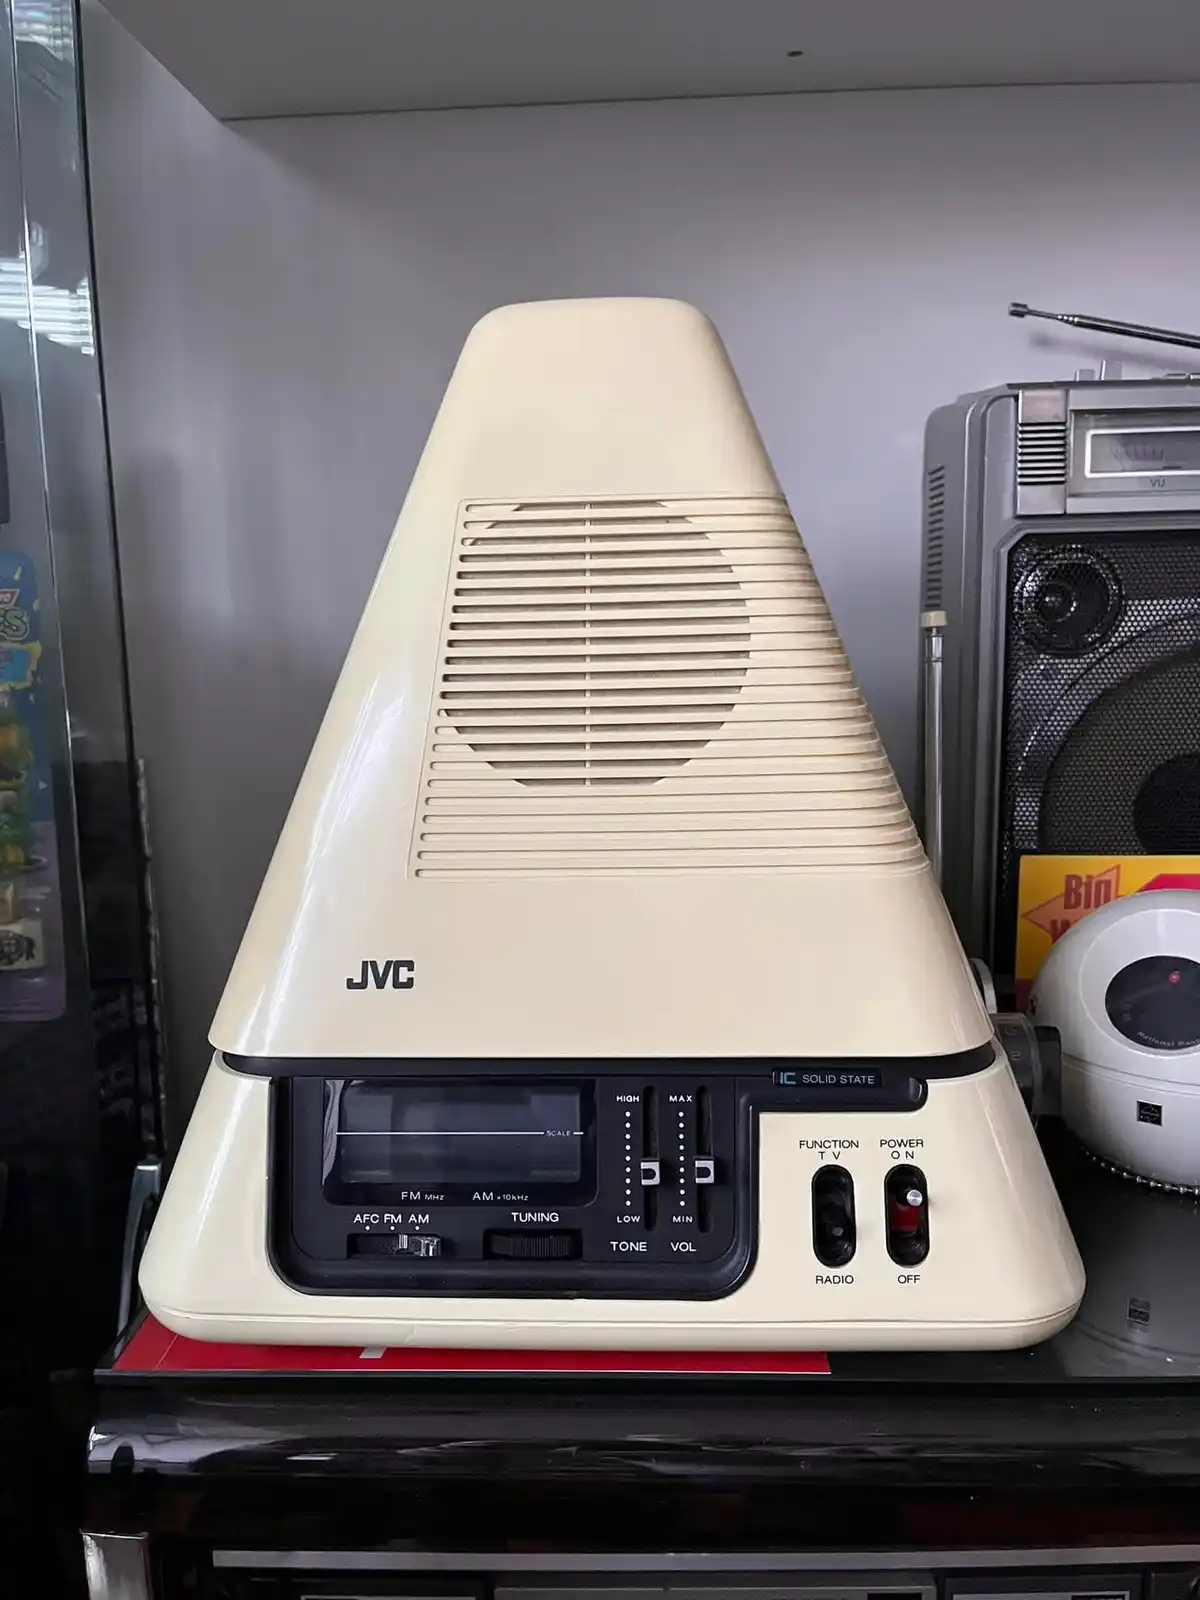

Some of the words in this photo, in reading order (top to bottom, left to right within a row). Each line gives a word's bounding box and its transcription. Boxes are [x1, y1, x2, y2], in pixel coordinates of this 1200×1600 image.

[346, 960, 415, 989] JVC
[779, 1071, 797, 1085] IC
[802, 1074, 837, 1084] SOLID
[839, 1074, 875, 1085] STATE
[616, 1094, 640, 1103] HIGH
[669, 1094, 693, 1102] MAX
[799, 1139, 860, 1150] FUNCTION
[879, 1138, 924, 1149] POWER
[401, 1191, 421, 1201] FM
[472, 1191, 494, 1201] AM
[496, 1193, 529, 1201] 10kHz
[353, 1213, 380, 1224] AFC
[383, 1213, 402, 1224] FM
[408, 1213, 430, 1224] AM
[511, 1211, 560, 1223] TUNING
[616, 1215, 641, 1223] LOW
[672, 1215, 693, 1223] MIN
[609, 1241, 647, 1252] TONE
[670, 1241, 697, 1252] VOL
[815, 1274, 855, 1285] RADIO
[897, 1274, 921, 1285] OFF
